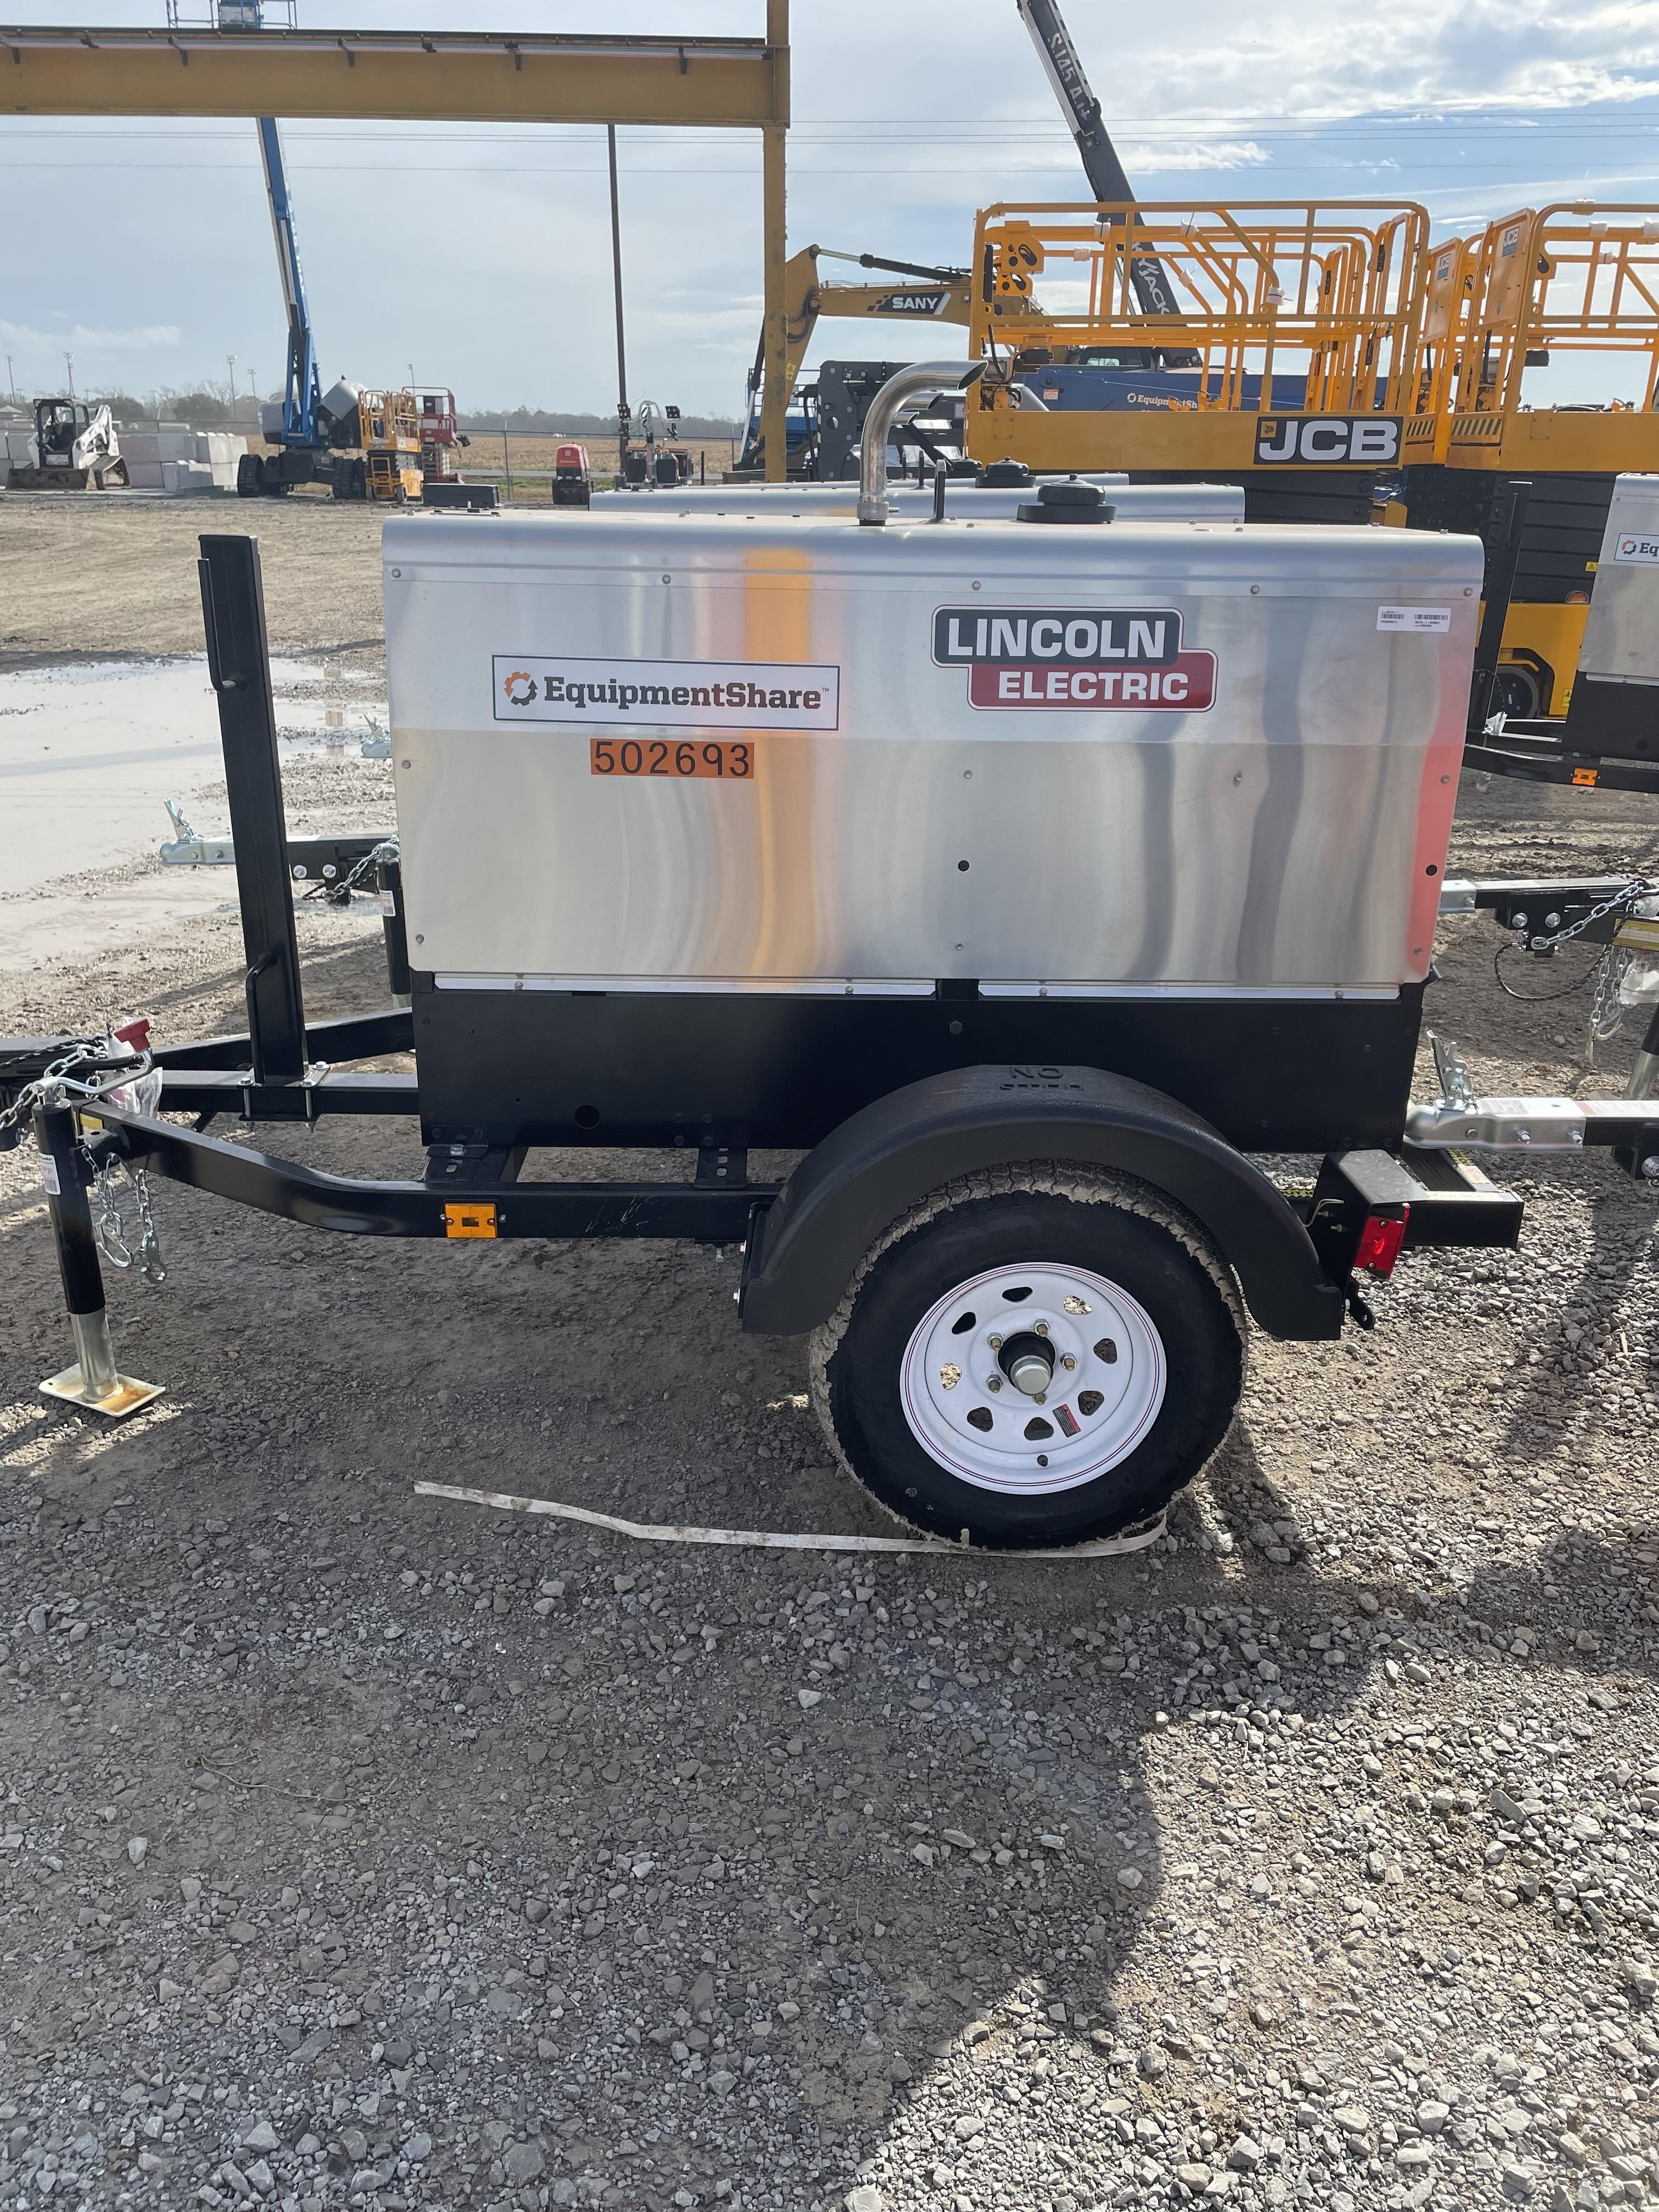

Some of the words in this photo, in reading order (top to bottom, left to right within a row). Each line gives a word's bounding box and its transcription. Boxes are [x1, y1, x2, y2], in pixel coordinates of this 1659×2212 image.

[1504, 227, 1519, 246] JCB
[1132, 241, 1171, 315] KYJACK
[1440, 254, 1451, 271] JCB
[892, 297, 939, 309] SANY
[1259, 420, 1398, 461] JCB
[948, 618, 1166, 658] LINCOLN
[544, 676, 821, 710] EquipmentShare
[998, 671, 1189, 701] ELECTRIC
[594, 741, 750, 777] 502693
[1009, 1066, 1064, 1080] NO
